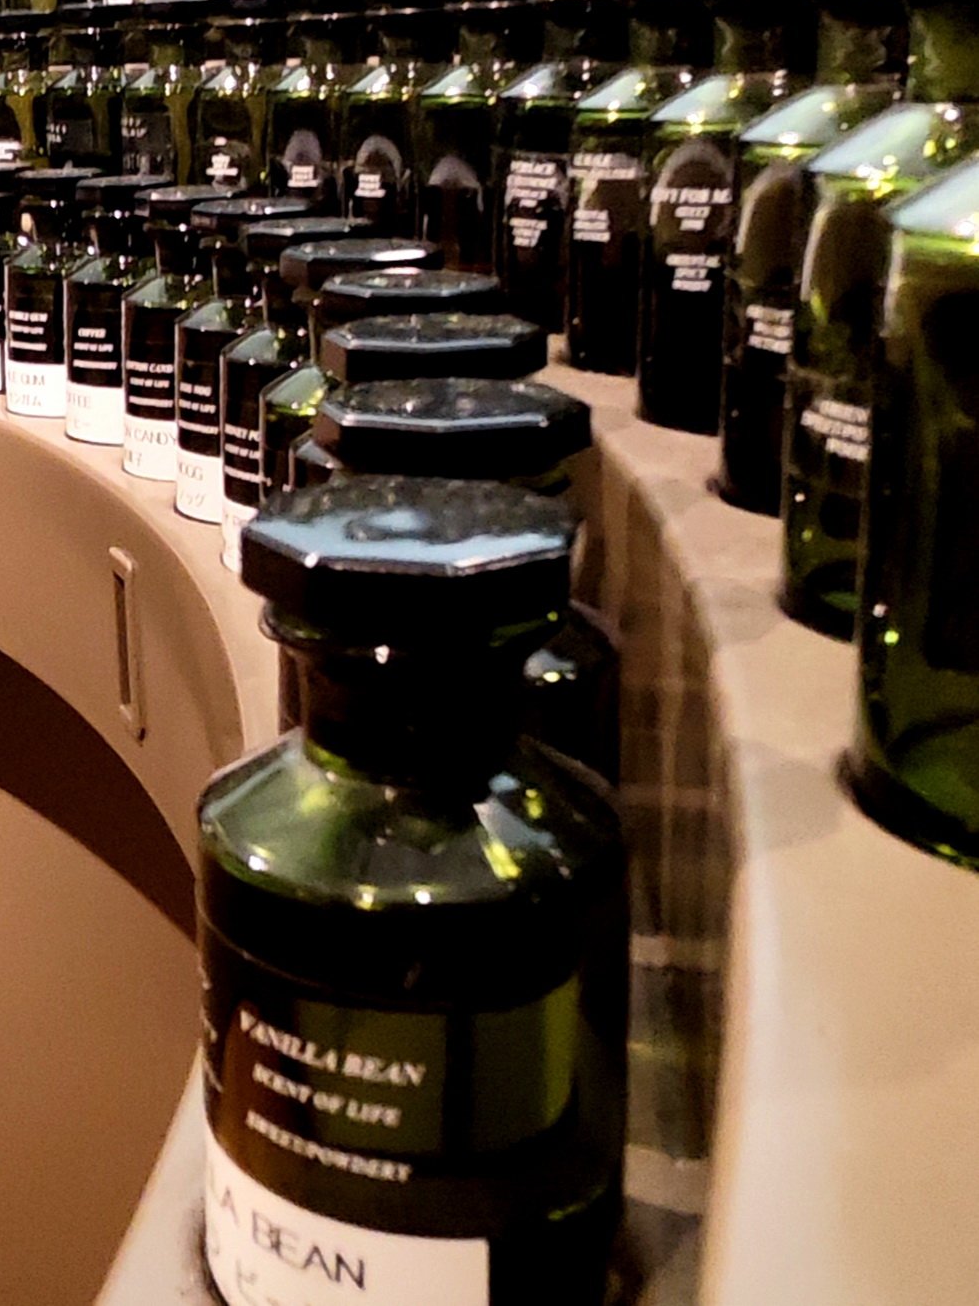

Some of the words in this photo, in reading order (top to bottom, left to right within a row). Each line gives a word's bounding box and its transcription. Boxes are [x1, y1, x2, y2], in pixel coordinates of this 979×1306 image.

[240, 1010, 339, 1073] VANILLA
[342, 1052, 427, 1087] BEAN
[252, 1062, 312, 1104] SCENT
[312, 1091, 346, 1114] OF
[345, 1099, 402, 1129] LIFE
[251, 1208, 367, 1291] BEAN
